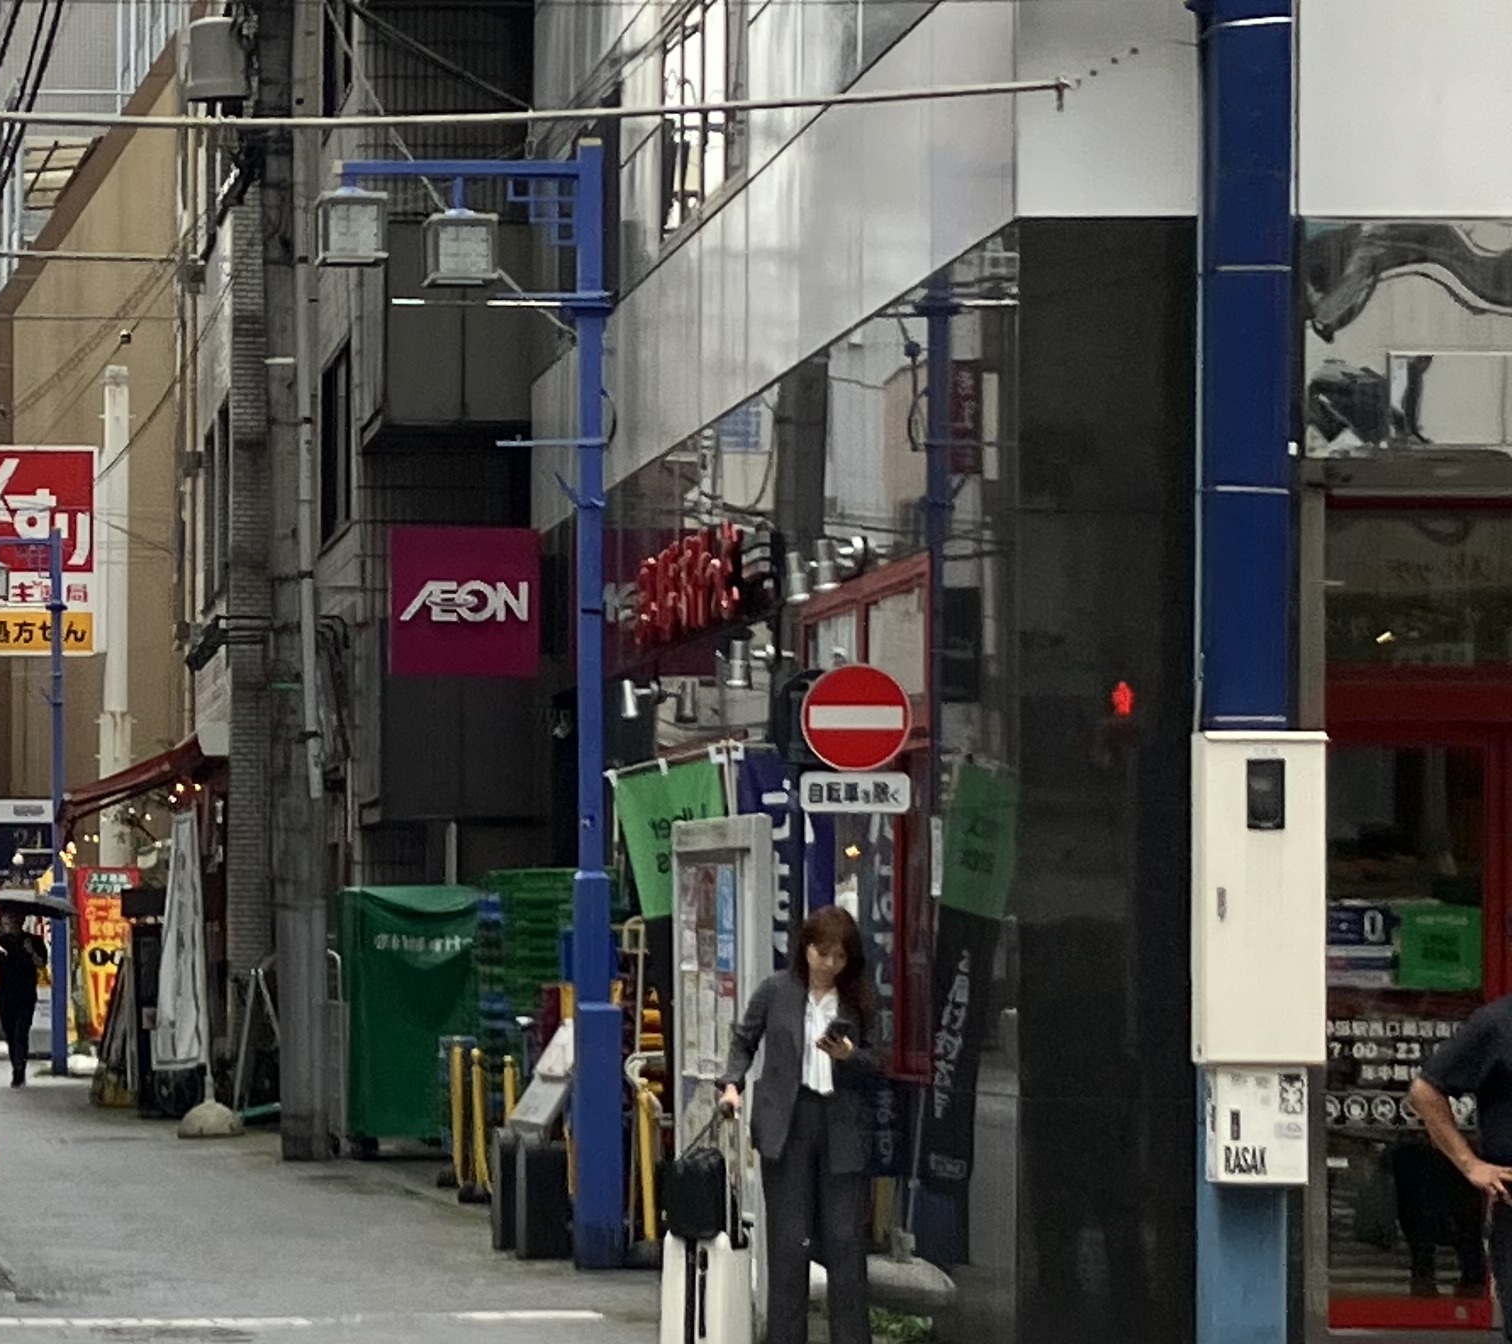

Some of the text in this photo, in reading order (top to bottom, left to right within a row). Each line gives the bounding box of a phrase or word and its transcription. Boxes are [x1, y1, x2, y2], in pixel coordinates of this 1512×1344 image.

[808, 781, 900, 804] 自転車を除く
